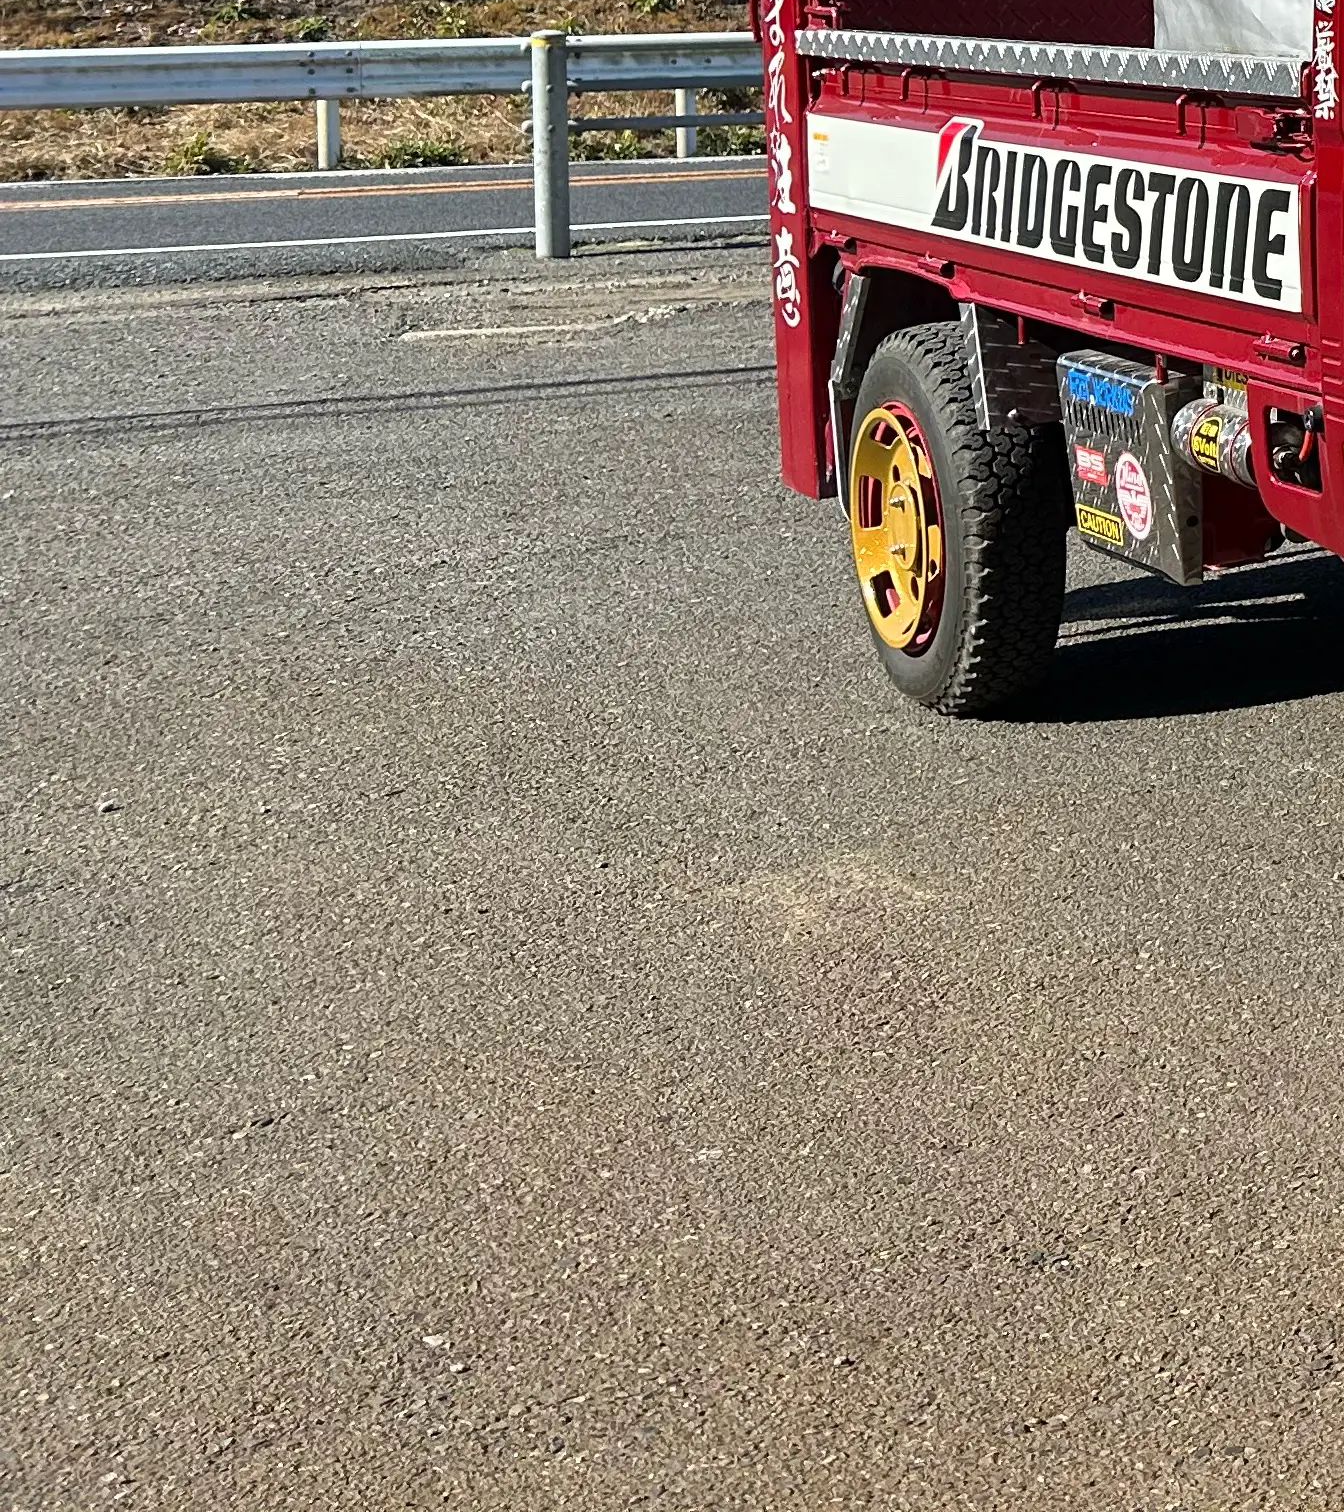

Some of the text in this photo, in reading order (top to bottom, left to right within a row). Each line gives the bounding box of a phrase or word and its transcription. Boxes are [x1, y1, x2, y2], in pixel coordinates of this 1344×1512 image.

[932, 119, 1288, 301] BRIDGESTONE
[1076, 449, 1105, 474] BS
[1080, 510, 1120, 542] CAUTION
